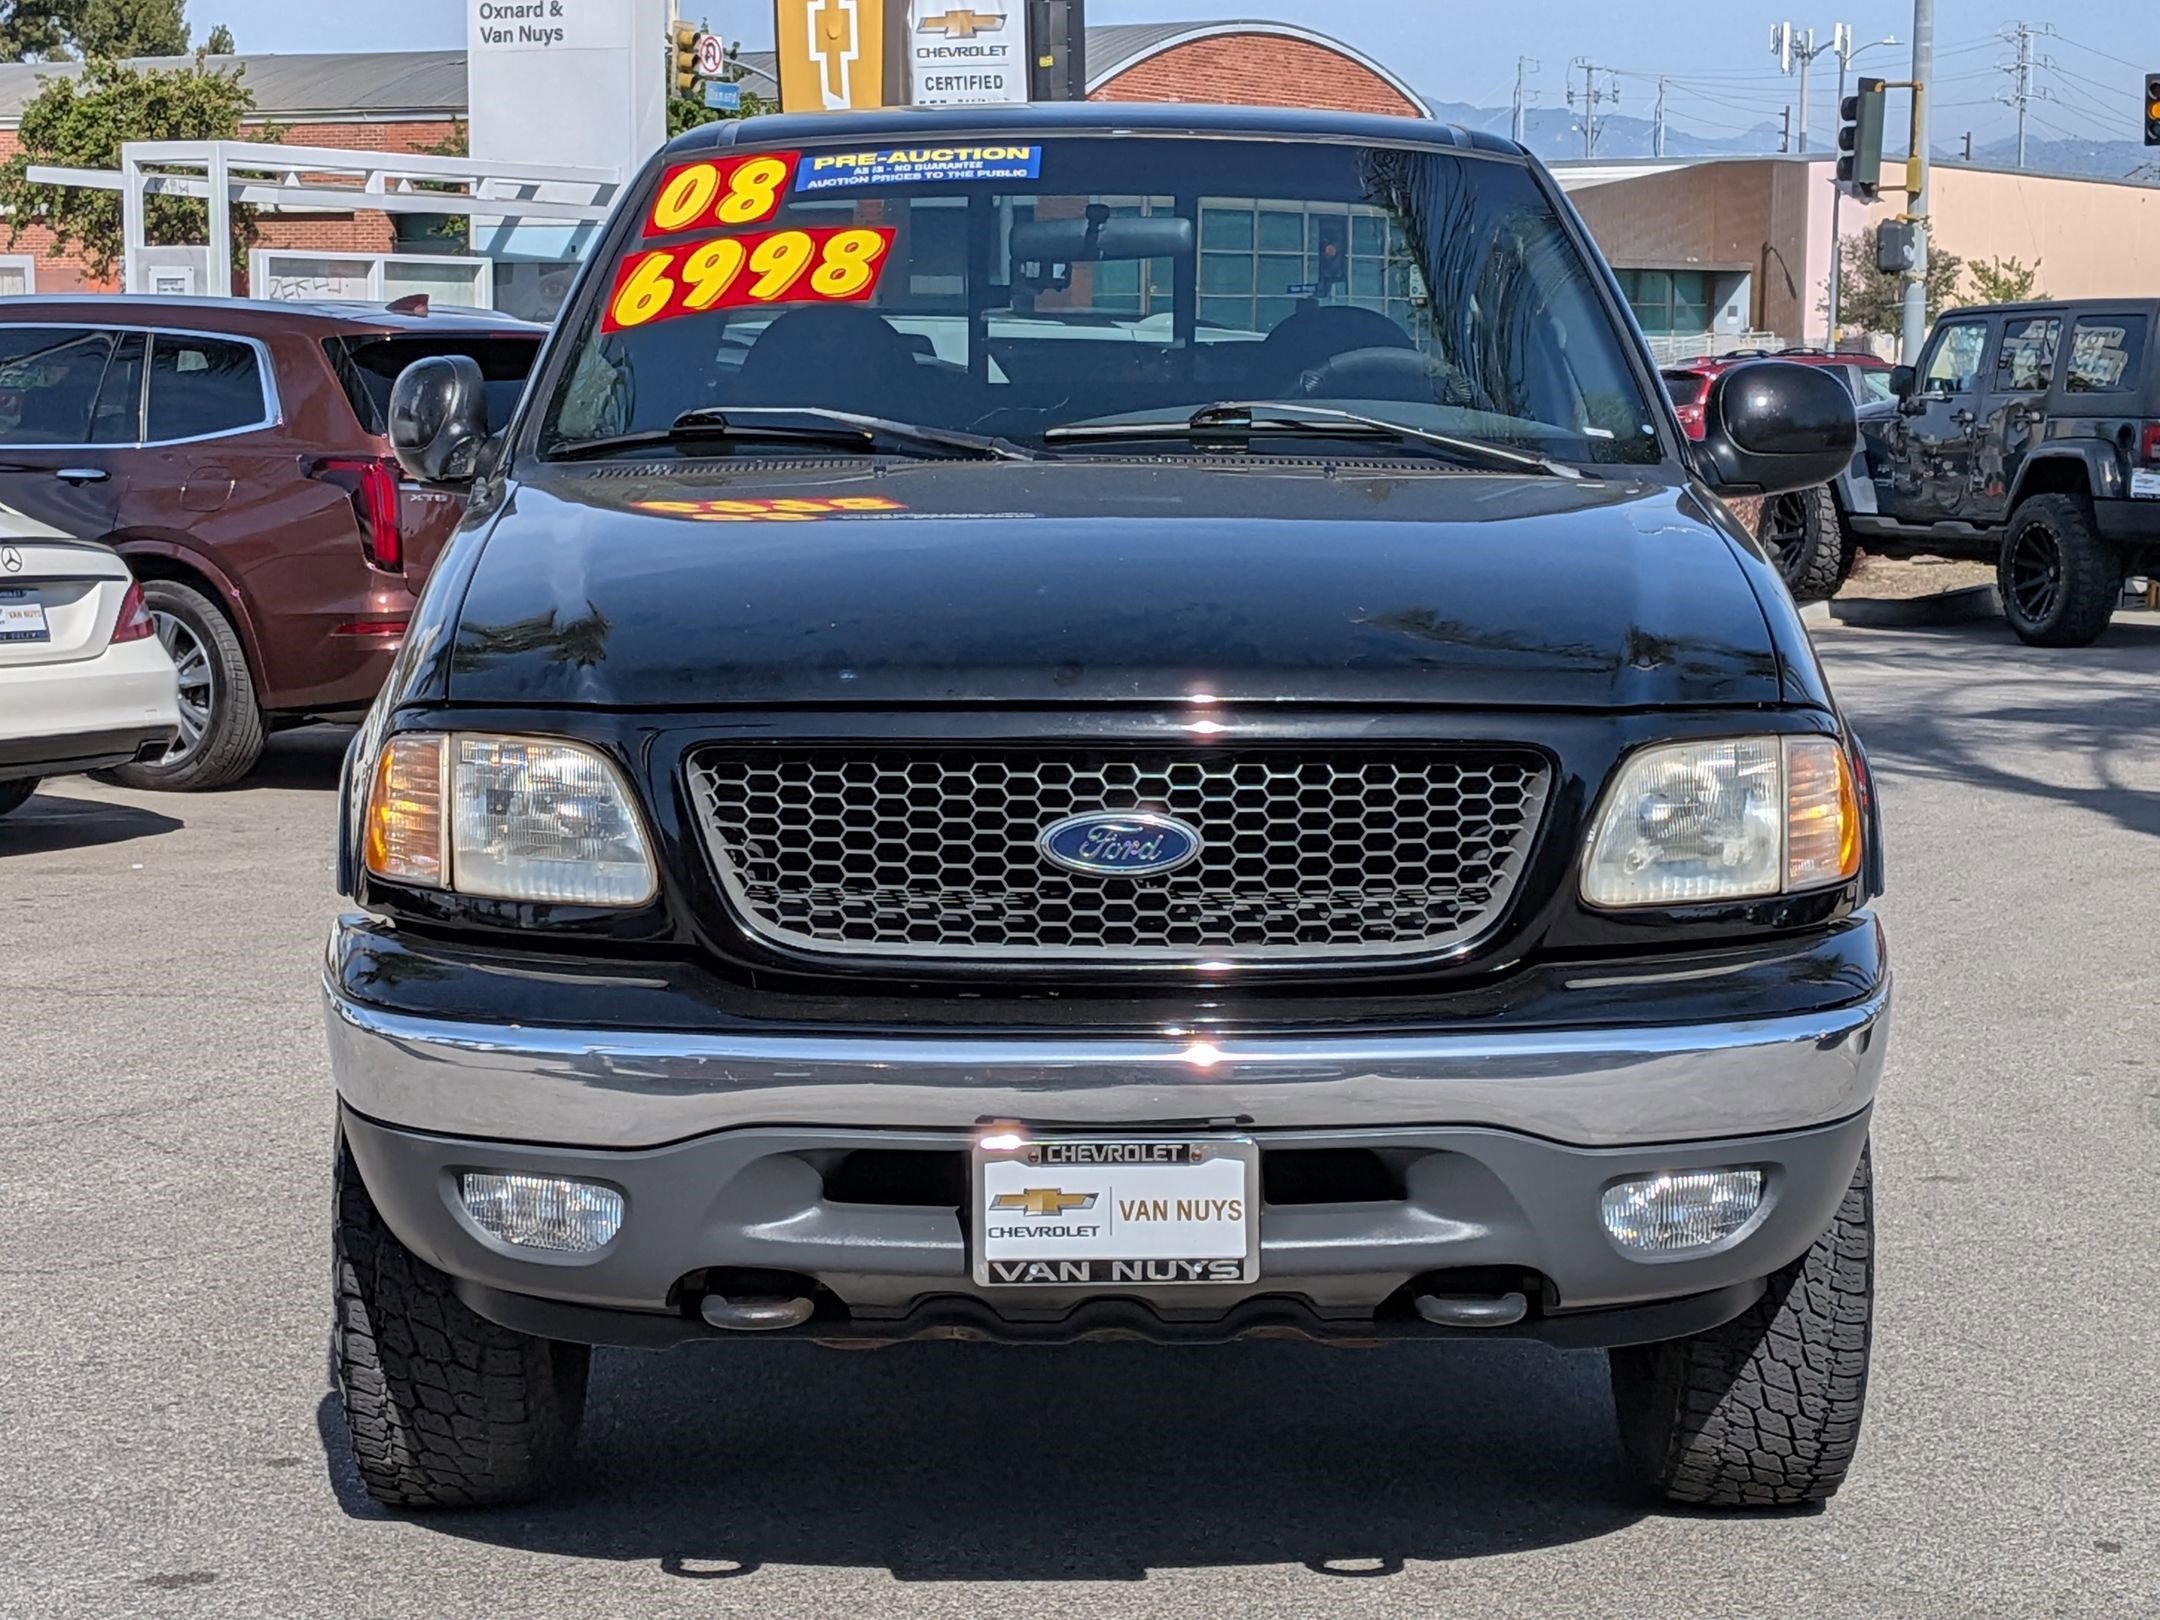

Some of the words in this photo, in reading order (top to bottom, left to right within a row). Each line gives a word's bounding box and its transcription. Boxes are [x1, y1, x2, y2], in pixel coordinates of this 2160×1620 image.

[480, 0, 544, 20] Oxnard
[549, 0, 563, 17] &
[480, 26, 514, 44] Van
[519, 25, 564, 46] Nuys
[916, 45, 1008, 58] CHEVROLET
[925, 75, 1003, 91] CERTIFIED
[814, 147, 1031, 170] PRE-AUCTION
[915, 161, 983, 171] GUARANTEE
[807, 175, 869, 189] AUCTION
[872, 172, 922, 183] PRICES
[925, 171, 942, 180] TO
[949, 170, 974, 178] THE
[977, 169, 1027, 177] PUBLIC
[653, 156, 788, 231] 08
[611, 229, 886, 327] 6998
[1078, 824, 1163, 860] Ford
[1046, 1144, 1182, 1162] CHEVROLET
[1119, 1200, 1168, 1222] VAN
[1177, 1200, 1243, 1222] NUYS
[988, 1226, 1100, 1239] CHEVROLET
[993, 1261, 1090, 1281] VAN
[1112, 1260, 1239, 1281] NUYS
